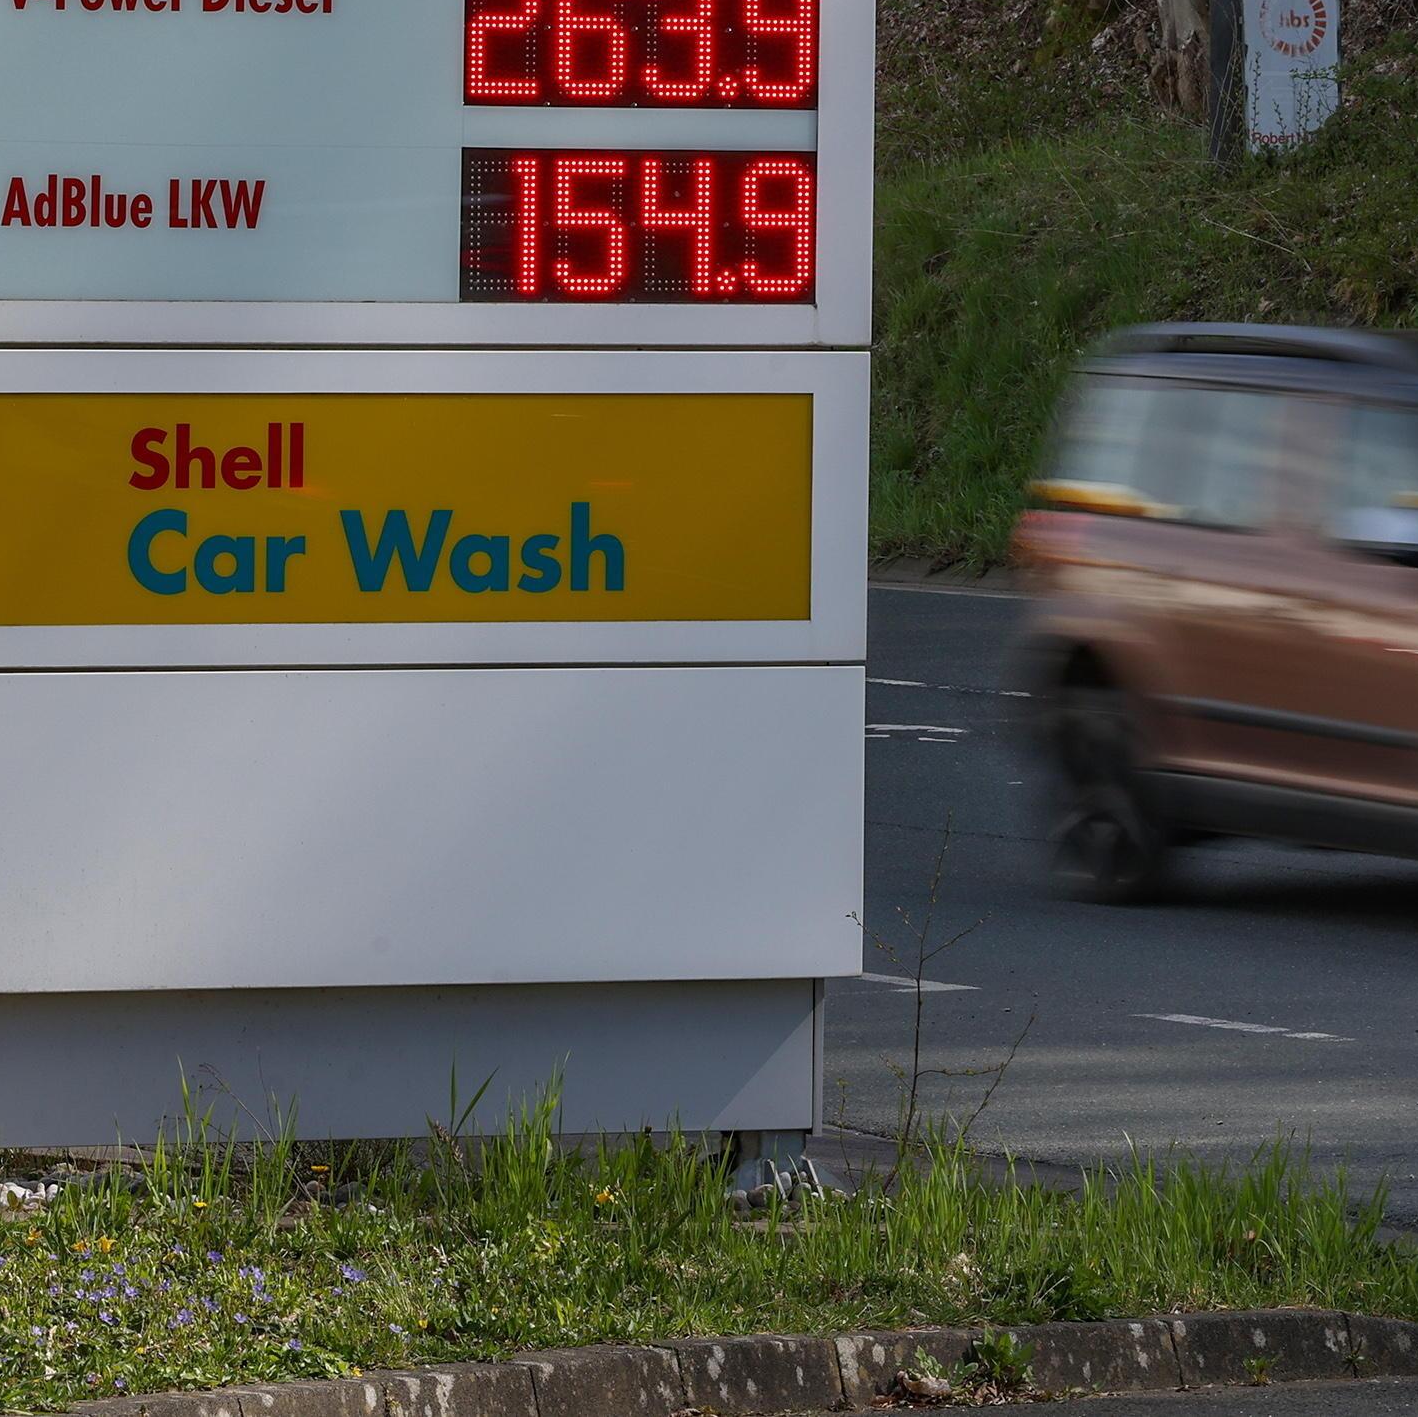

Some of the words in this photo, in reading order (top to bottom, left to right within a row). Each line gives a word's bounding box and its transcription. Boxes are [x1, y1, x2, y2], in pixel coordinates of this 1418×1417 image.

[1, 174, 153, 229] AdBlue
[168, 179, 265, 228] LKW
[513, 157, 811, 295] 154.9
[128, 422, 304, 490] Shell
[127, 508, 306, 595] Car
[340, 502, 625, 594] Wash
